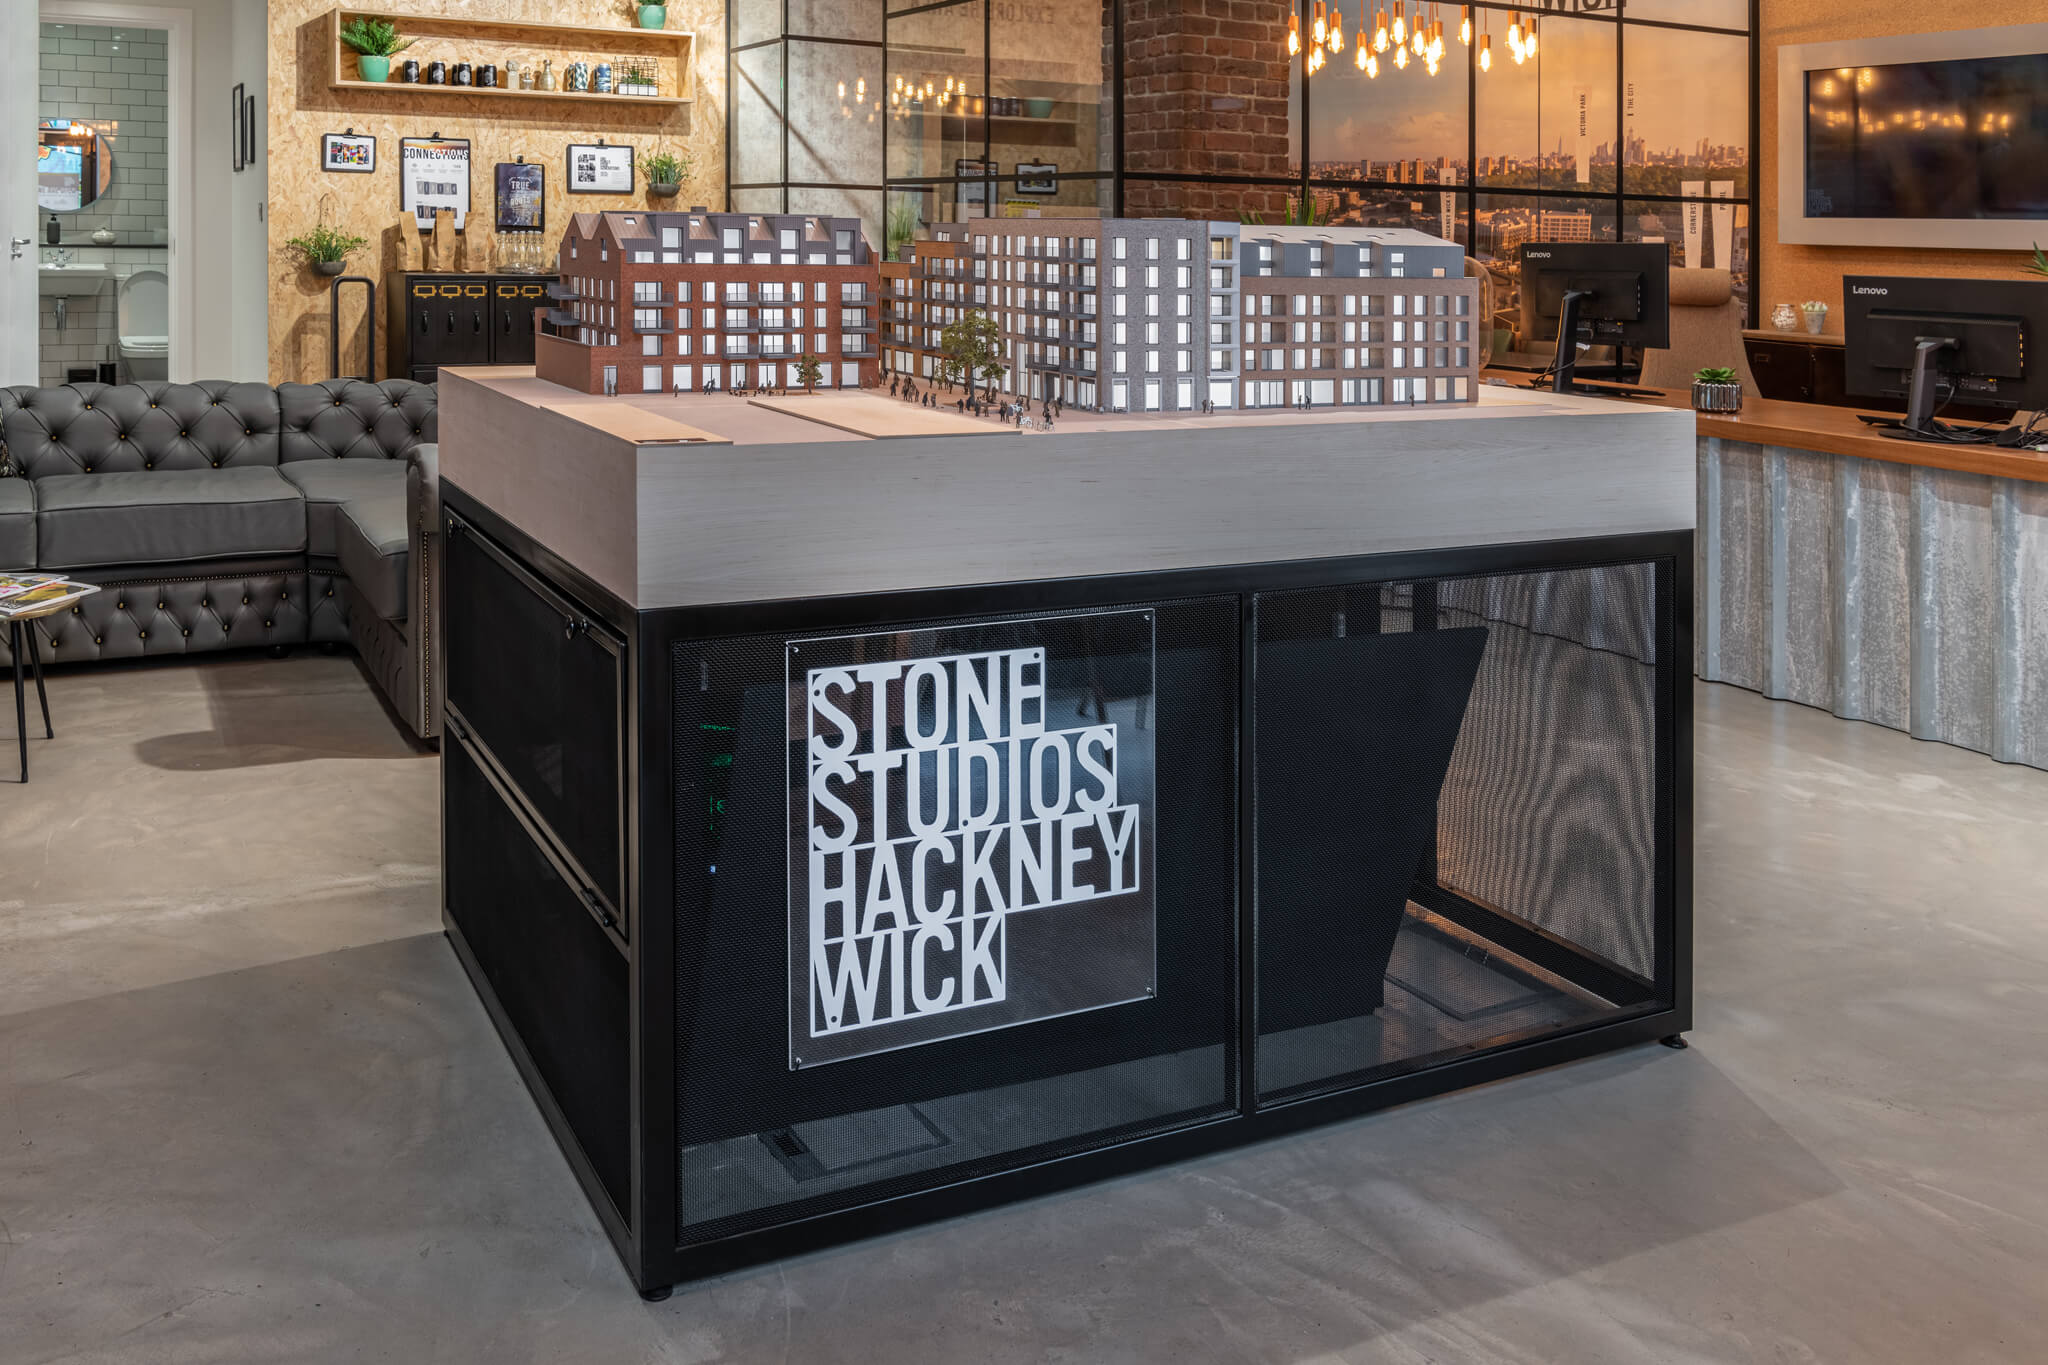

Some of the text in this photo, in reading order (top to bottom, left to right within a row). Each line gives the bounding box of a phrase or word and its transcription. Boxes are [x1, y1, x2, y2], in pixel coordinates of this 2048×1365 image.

[403, 147, 469, 160] CONNECTIONS
[511, 181, 530, 190] TRUE
[1852, 285, 1888, 295] Lenovo
[810, 649, 1044, 759] STONE
[810, 726, 1117, 851] STUDIOS
[809, 805, 1139, 942] HACKNEY
[810, 910, 1006, 1036] WICK
